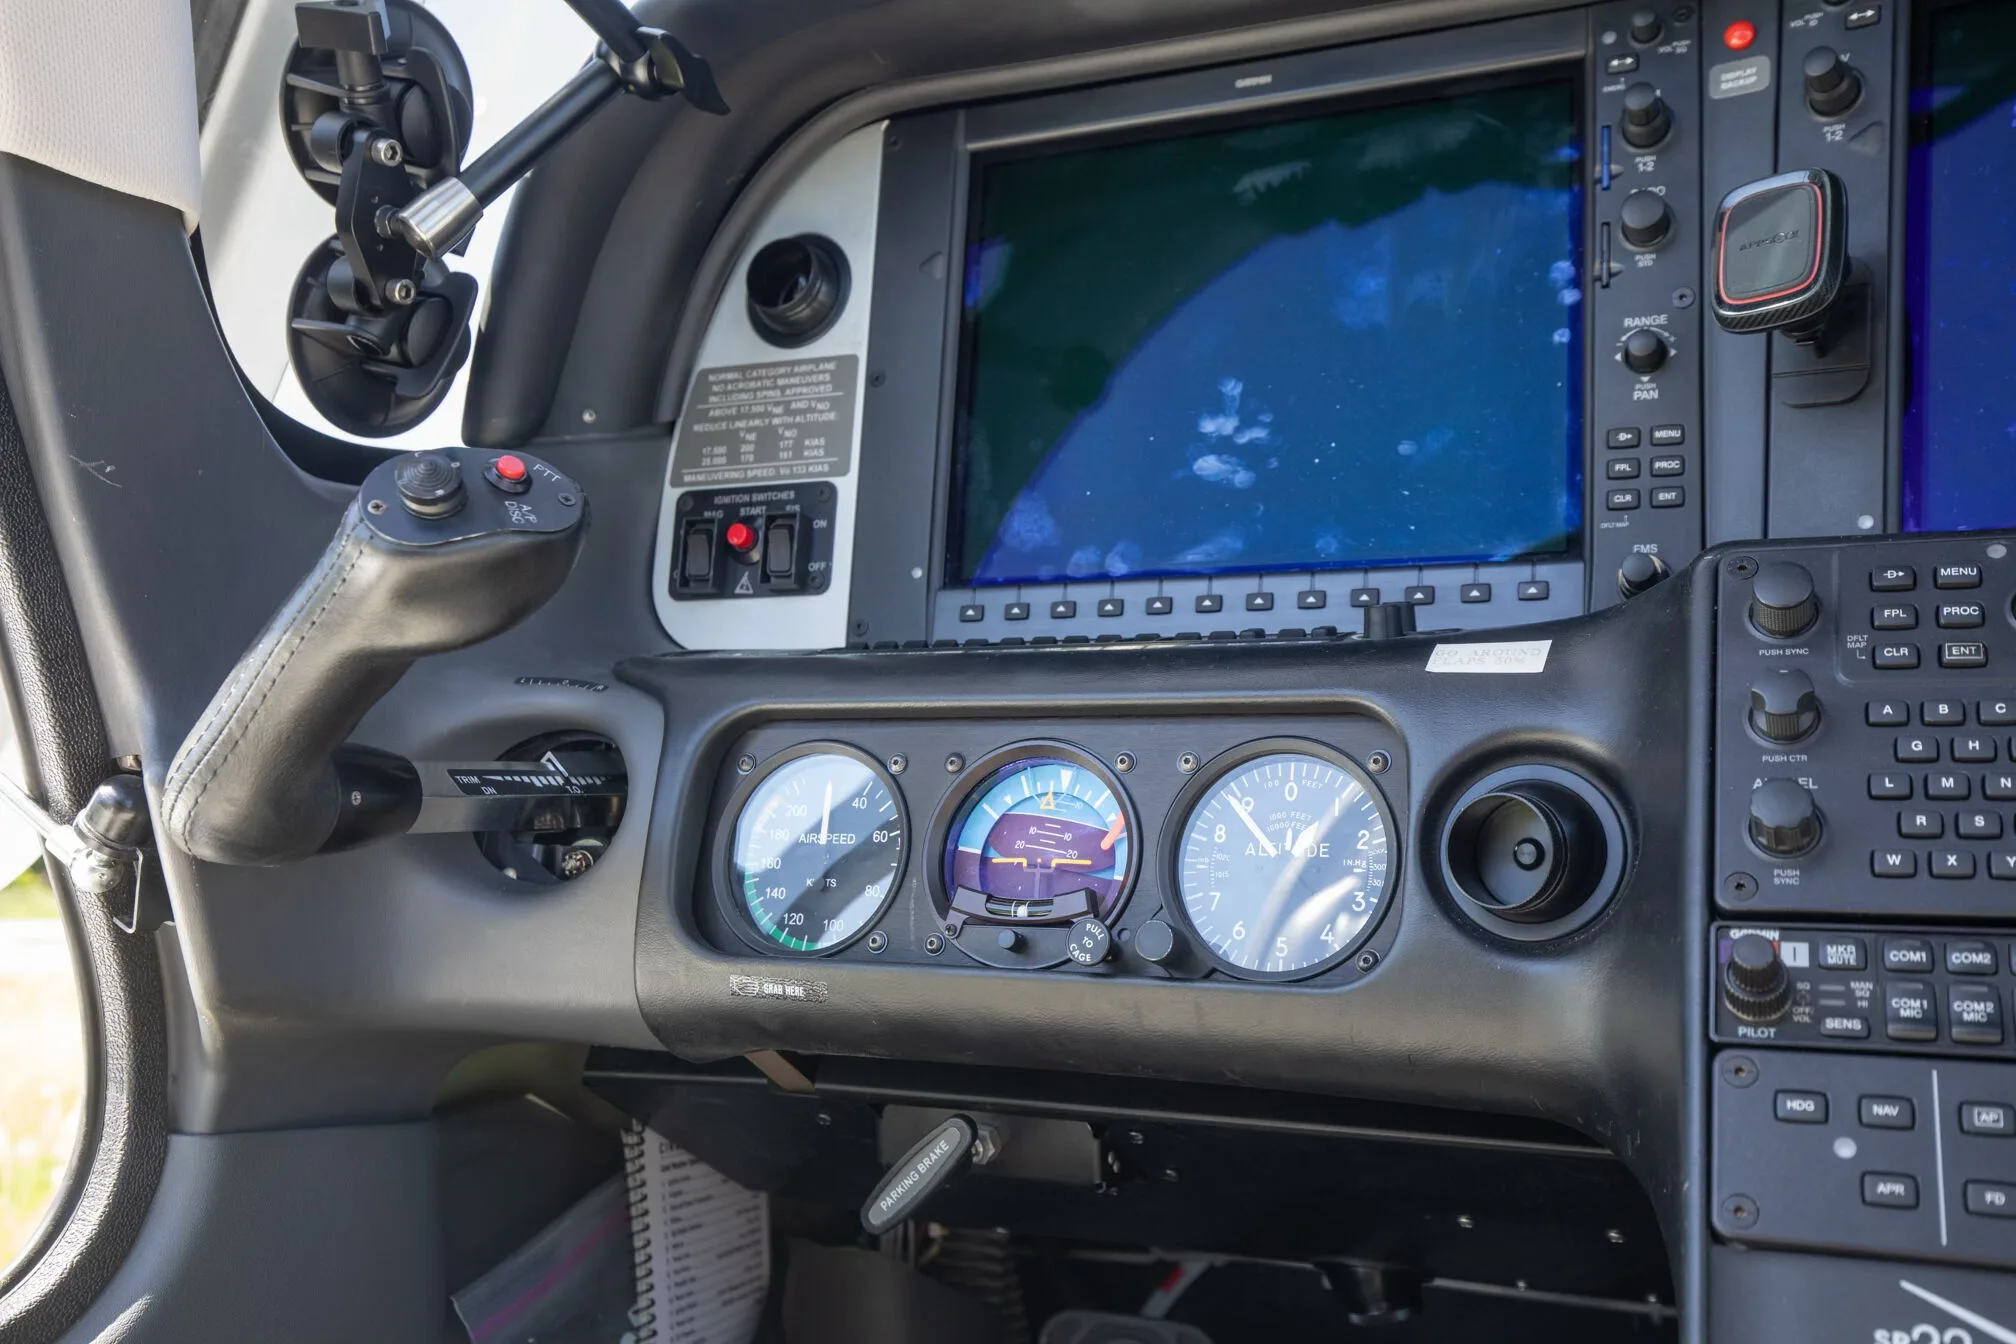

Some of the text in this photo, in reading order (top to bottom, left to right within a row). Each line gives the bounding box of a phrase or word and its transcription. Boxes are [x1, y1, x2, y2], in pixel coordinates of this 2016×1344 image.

[1825, 130, 1843, 142] 1-2
[1623, 314, 1668, 328] RANGE
[708, 361, 836, 382] NORMAL CATEGORY AIRPLANE
[712, 383, 725, 392] NO
[777, 373, 831, 385] MANEUVERS
[1633, 389, 1659, 400] PAN
[708, 407, 737, 417] ABOVE
[790, 400, 809, 409] AND
[693, 416, 793, 432] REDUCE LINEARLY WITH
[1654, 430, 1681, 438] MENU
[1655, 461, 1680, 469] PROC
[533, 464, 561, 482] PTT
[684, 463, 829, 482] MANEUVERING KIAS
[714, 491, 795, 505] IGNITION SWITCHES
[1614, 495, 1632, 503] CLR
[1658, 492, 1677, 500] ENT
[505, 500, 525, 524] DISC
[740, 506, 767, 517] START
[813, 519, 827, 529] ON
[1632, 544, 1658, 554] FMS
[808, 562, 826, 572] OFF
[1940, 567, 1977, 576] MENU
[1884, 609, 1907, 618] FPL
[1944, 606, 1980, 615] PROC
[1759, 649, 1783, 657] PUSH
[1884, 648, 1909, 657] CLR
[1952, 646, 1977, 655] ENT
[1883, 705, 1893, 715] A
[1939, 704, 1949, 714] B
[1995, 703, 2006, 713] C
[1911, 740, 1922, 750] G
[1969, 740, 1979, 750] H
[1762, 754, 1807, 763] PUSH CTR
[454, 776, 481, 784] TRIM
[1302, 779, 1323, 790] FEET
[1885, 777, 1894, 787] L
[1941, 778, 1954, 788] M
[2001, 778, 2012, 788] N
[481, 787, 497, 795] DN
[1284, 782, 1298, 801] 0
[852, 798, 867, 809] 40
[1240, 797, 1254, 813] 9
[785, 805, 807, 817] 200
[1290, 811, 1312, 821] FEET
[1916, 815, 1927, 826] R
[1974, 816, 1985, 827] S
[873, 831, 888, 843] 60
[1029, 827, 1037, 836] 10
[1063, 832, 1072, 841] 10
[1214, 824, 1227, 843] 8
[799, 834, 856, 845] AIRSPEED
[1014, 841, 1025, 849] 20
[1357, 830, 1370, 850] 2
[1066, 850, 1078, 859] 20
[1887, 855, 1901, 865] W
[761, 858, 782, 869] 160
[1947, 855, 1957, 866] X
[2006, 856, 2016, 867] Y
[1774, 869, 1800, 877] PUSH
[806, 878, 837, 888] KTS
[1774, 877, 1800, 885] SYNC
[766, 888, 786, 899] 140
[865, 885, 880, 897] 80
[1209, 892, 1221, 911] 7
[1352, 892, 1366, 912] 3
[784, 913, 804, 926] 120
[823, 920, 844, 932] 100
[1232, 920, 1246, 940] 6
[1086, 923, 1105, 941] PULL
[1320, 924, 1334, 944] 4
[1082, 936, 1093, 948] TO
[1275, 937, 1288, 958] 5
[1069, 943, 1092, 962] CAGE
[1827, 945, 1856, 956] MKR
[1827, 955, 1857, 965] MUTE
[1890, 951, 1926, 963] COM1
[1952, 952, 1992, 964] COM2
[763, 983, 804, 997] GRAB HERE
[1850, 981, 1873, 991] MAN
[1793, 1015, 1811, 1023] VOL
[1899, 1009, 1922, 1018] MIC
[1962, 1012, 1988, 1022] MIC
[1825, 1017, 1862, 1030] SENS
[1738, 1026, 1776, 1038] PILOT
[1786, 1100, 1815, 1112] HDG
[1872, 1105, 1900, 1117] NAV
[880, 1140, 949, 1212] PARKING BRAKE
[1877, 1183, 1905, 1196] APR
[1985, 1192, 2006, 1206] FD
